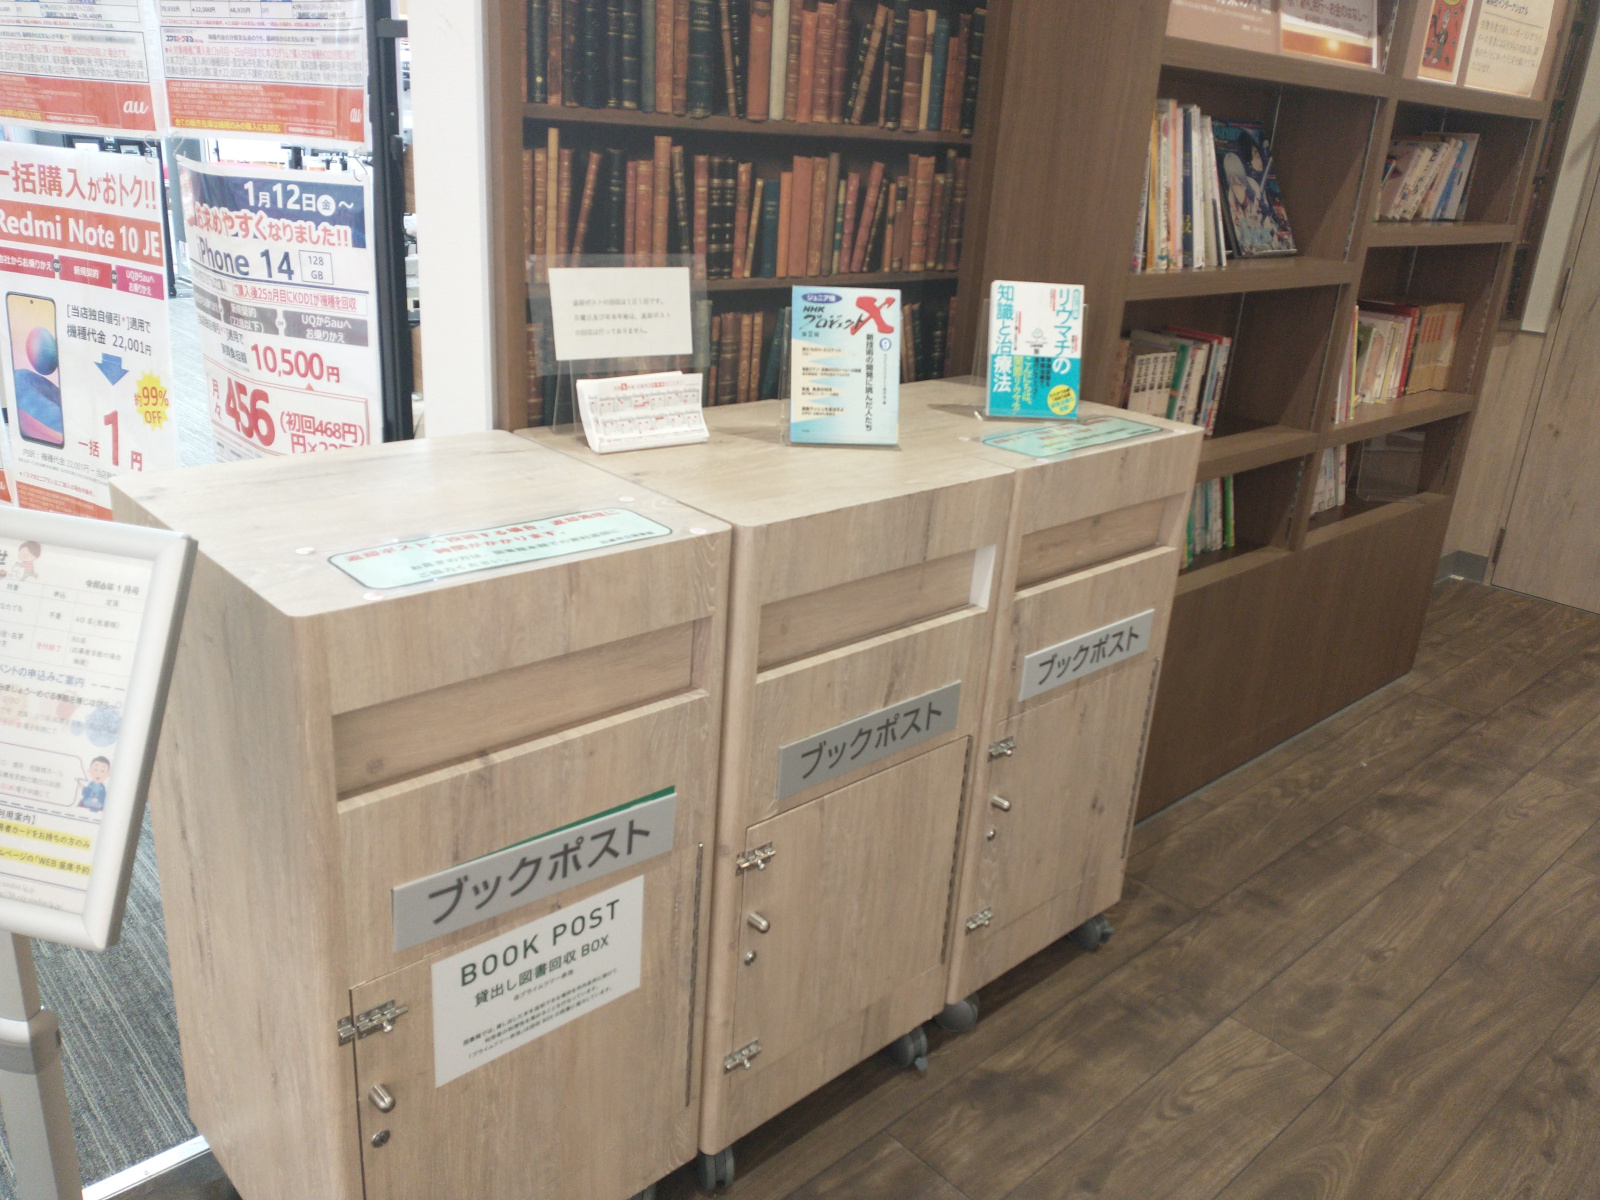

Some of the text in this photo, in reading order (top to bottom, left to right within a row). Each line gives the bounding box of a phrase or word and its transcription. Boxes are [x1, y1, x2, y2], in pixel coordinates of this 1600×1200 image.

[123, 100, 149, 115] au
[68, 217, 115, 249] Note
[119, 225, 138, 254] 10
[142, 230, 161, 258] JE
[73, 265, 99, 280] 新規契約
[125, 269, 155, 284] UQからauへ
[260, 249, 294, 281] 14
[308, 255, 324, 266] 128
[310, 270, 324, 280] GB
[301, 314, 352, 330] UQからauへ
[803, 305, 825, 313] NHK
[66, 323, 152, 356] 機種代金 22,001円
[305, 328, 346, 345] お乗りかえ
[993, 284, 1014, 393] 知識と治療法
[1052, 288, 1074, 375] リウマチの
[251, 343, 341, 384] 10,500円
[134, 386, 169, 408] 約99%
[224, 376, 276, 447] 456
[144, 410, 163, 424] OFF
[279, 410, 365, 447] (初回468円)
[53, 590, 66, 600] 申込
[1037, 625, 1140, 686] ブックポスト
[801, 701, 942, 780] ブックポスト
[428, 819, 651, 926] ブックポスト
[460, 898, 620, 987] BOOK POST
[474, 934, 610, 1008] 貸出し図書回収 BOX
